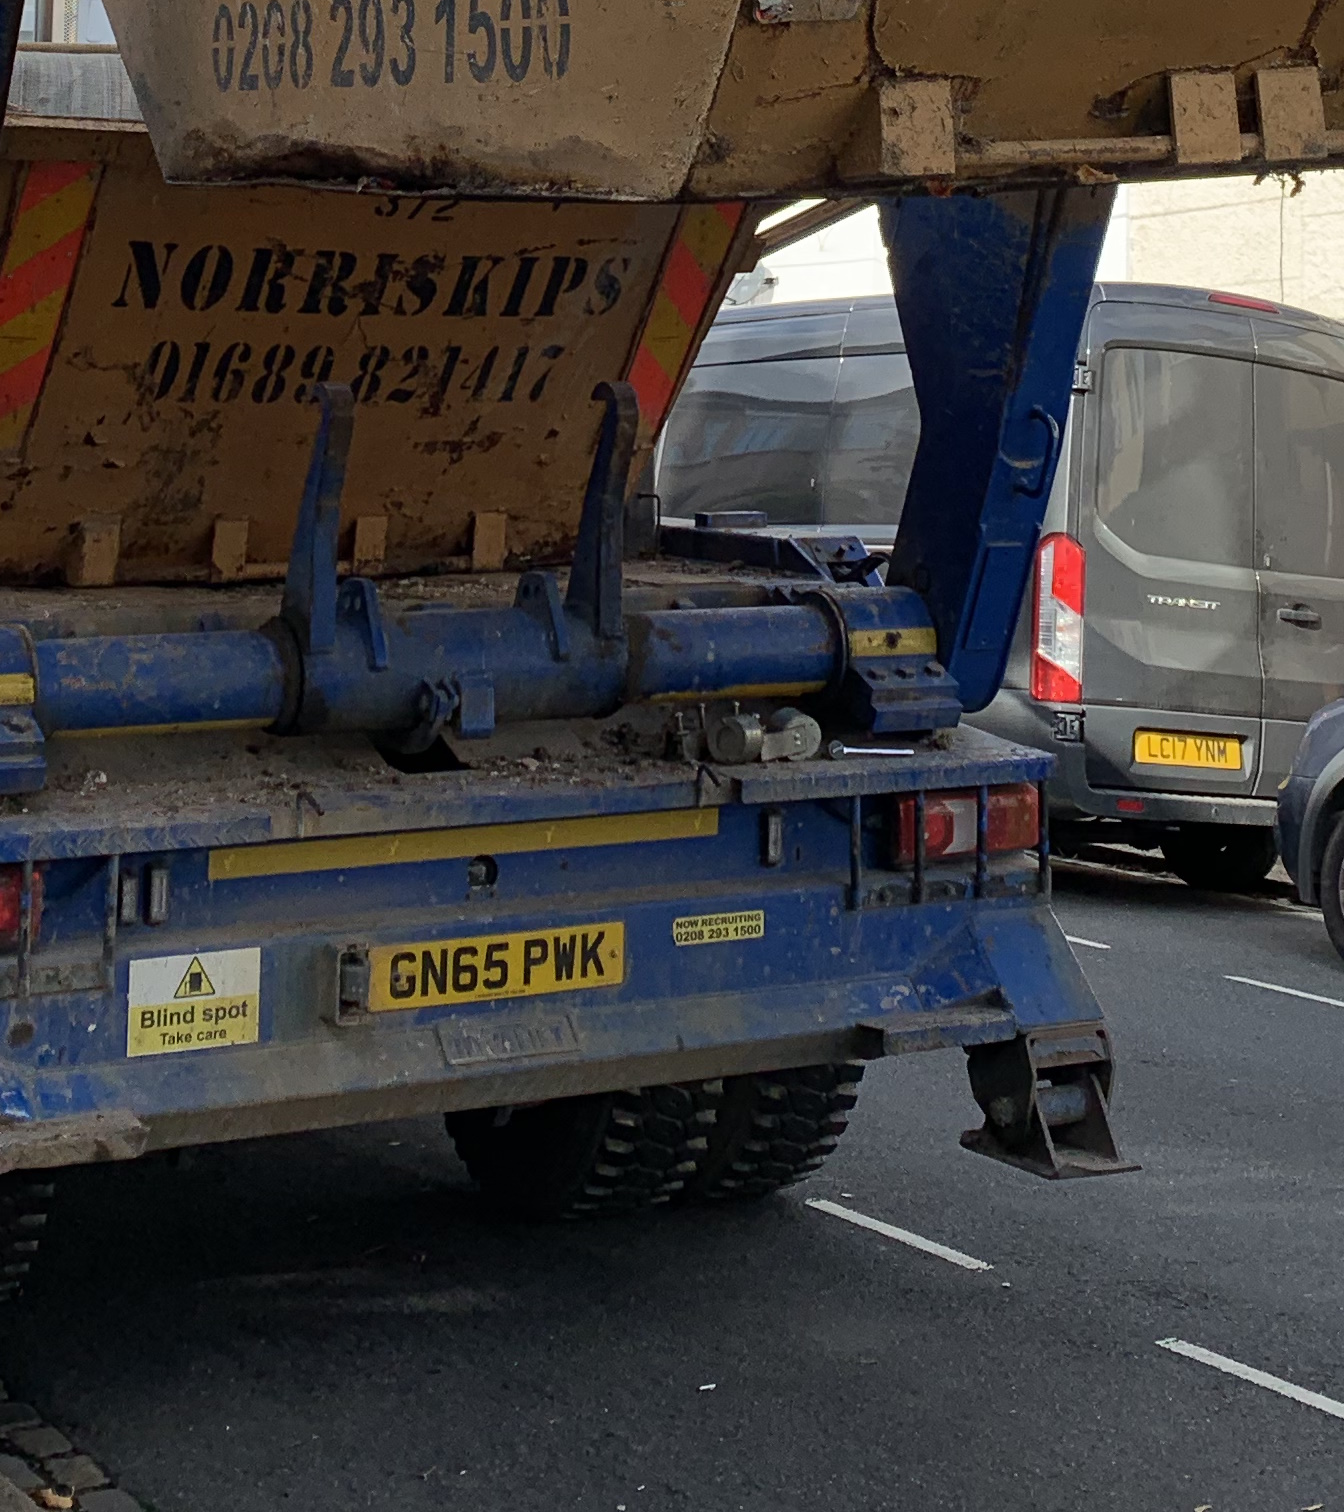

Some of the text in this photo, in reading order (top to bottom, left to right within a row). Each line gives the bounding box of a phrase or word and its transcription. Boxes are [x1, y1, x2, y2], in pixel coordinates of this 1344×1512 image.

[1147, 594, 1221, 610] TRANSIT
[1147, 736, 1187, 761] LC17
[676, 913, 762, 929] NOW RECRUITING
[676, 924, 761, 942] 0208 293 1500
[389, 931, 605, 1000] GN65 PWK
[140, 1000, 248, 1029] Blind spot
[160, 1029, 227, 1045] Take care
